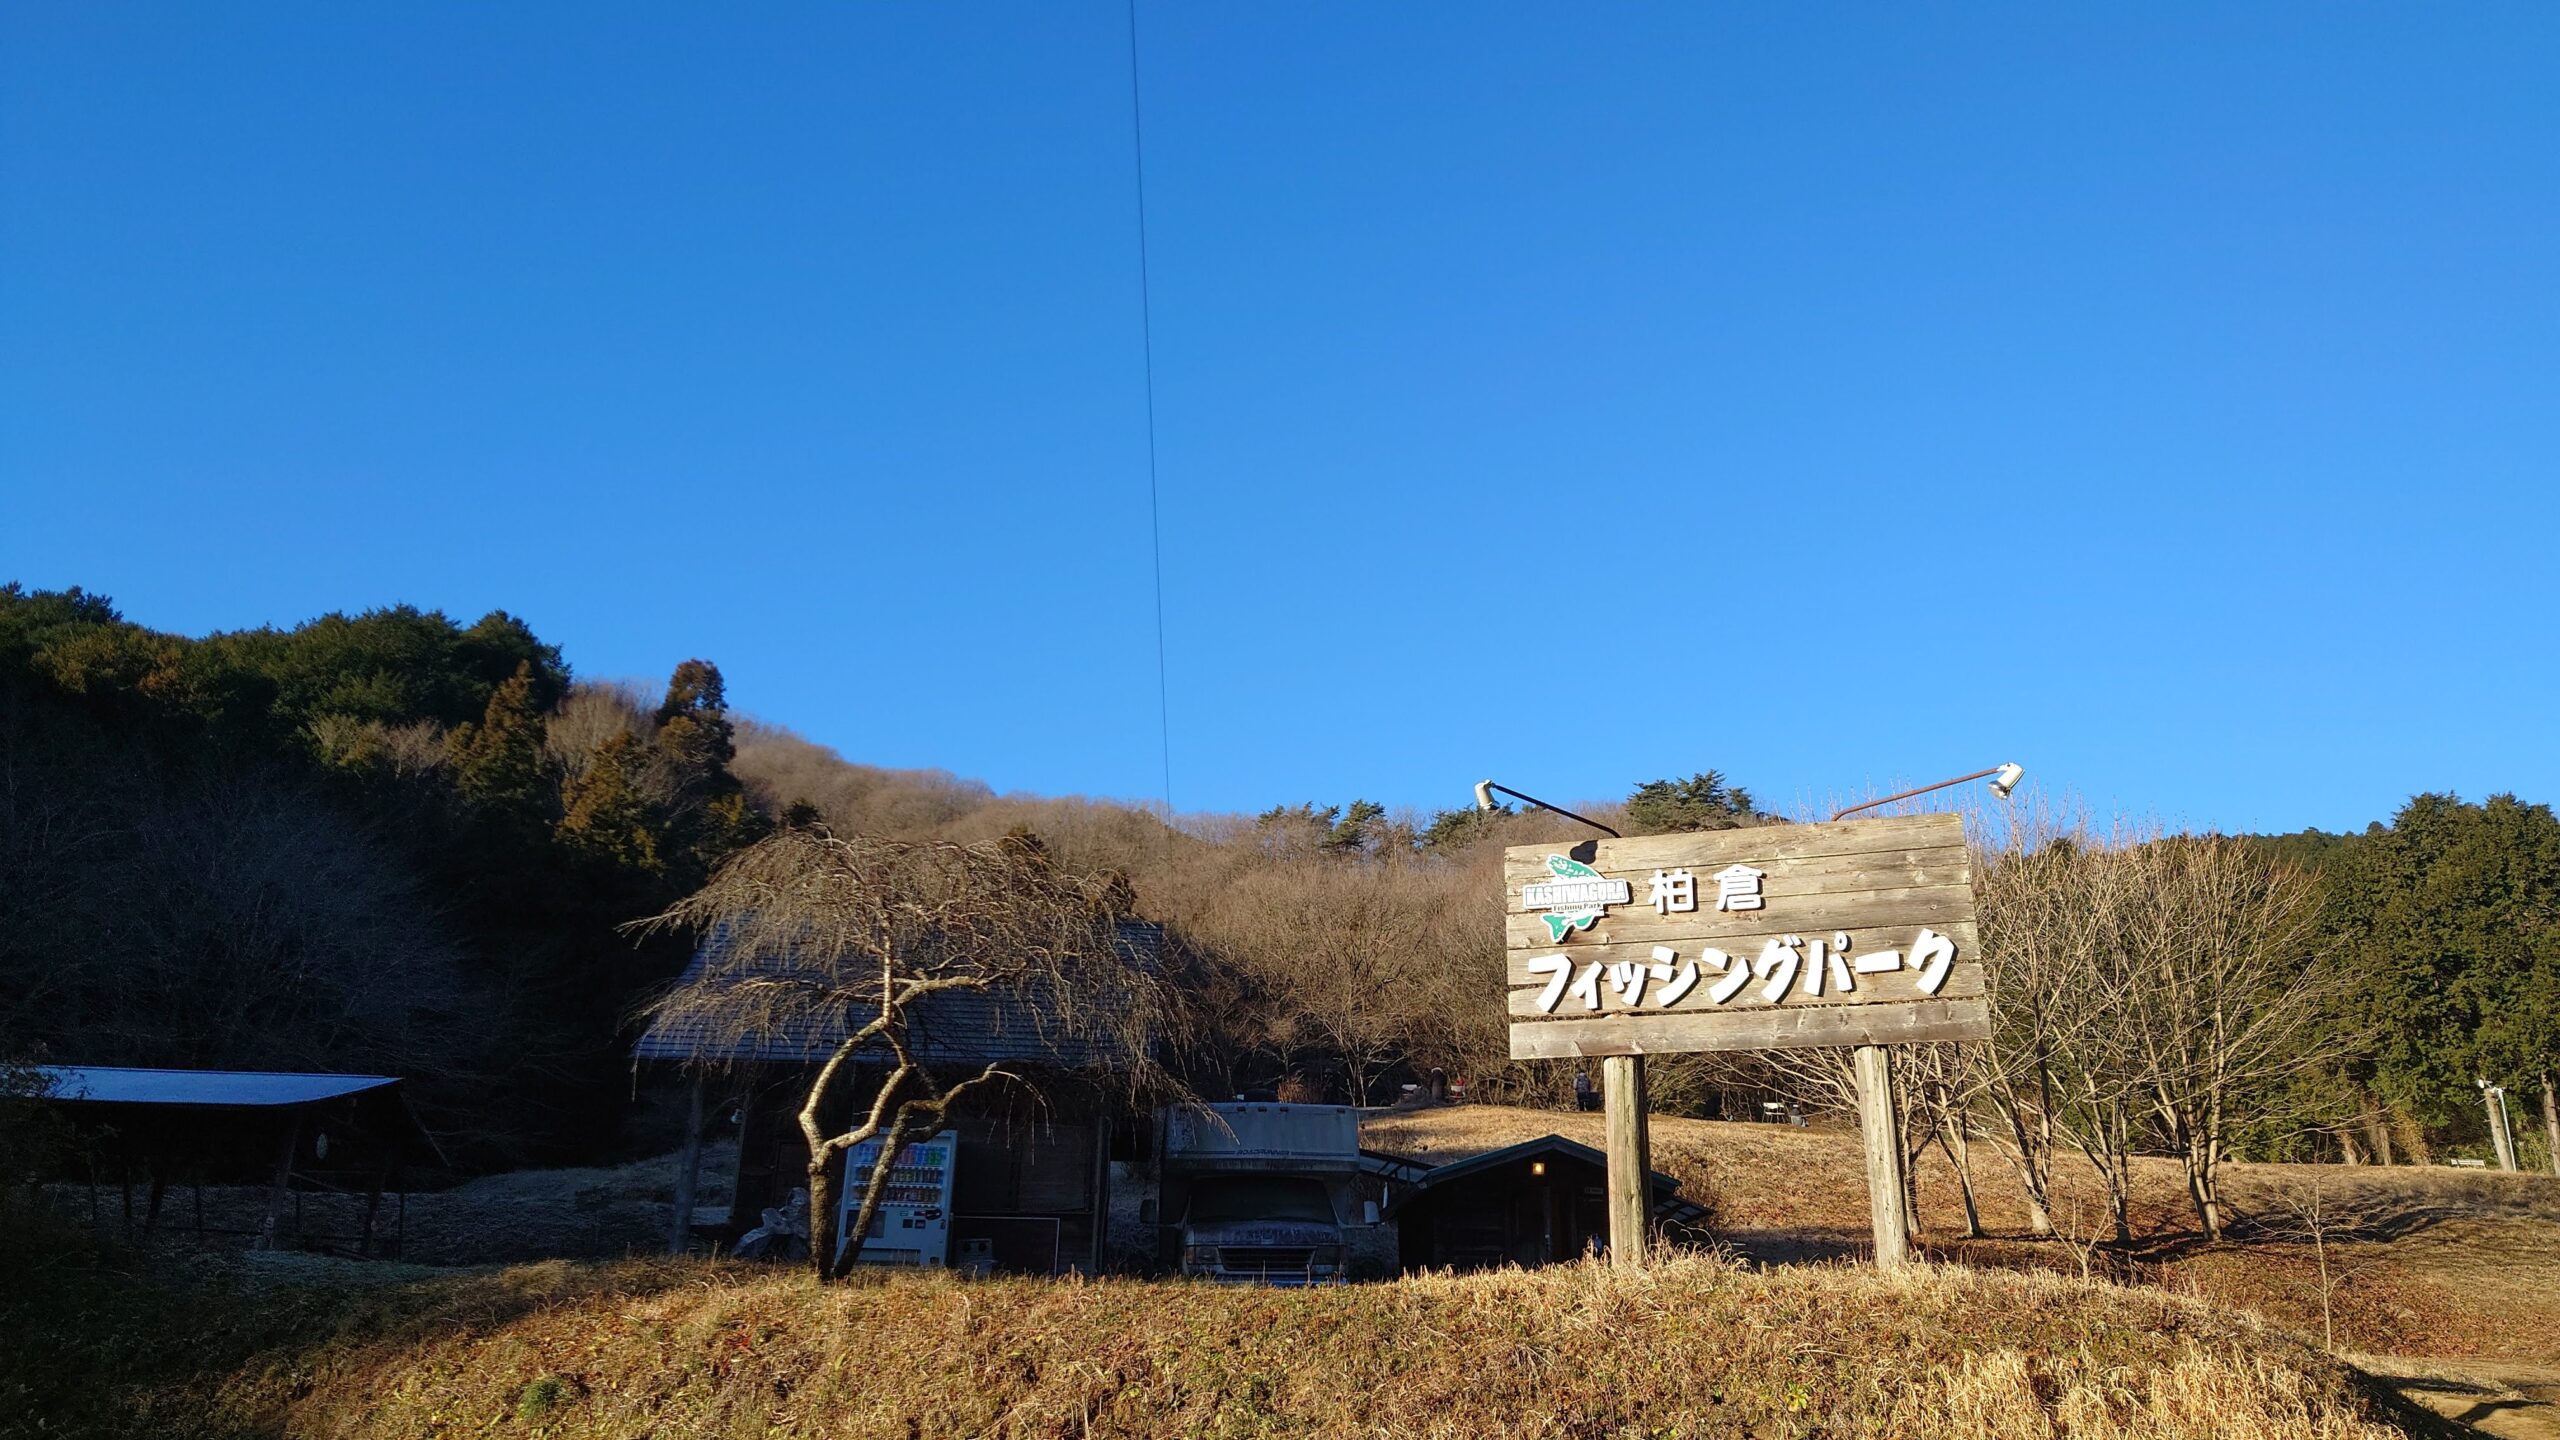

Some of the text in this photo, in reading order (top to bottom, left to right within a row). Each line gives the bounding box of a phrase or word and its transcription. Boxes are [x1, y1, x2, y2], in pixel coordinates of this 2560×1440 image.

[1525, 881, 1627, 906] KASHIWAGURA
[1583, 902, 1603, 910] Park
[1648, 864, 1765, 914] 柏倉
[1528, 928, 1955, 1013] フィッシングパーク
